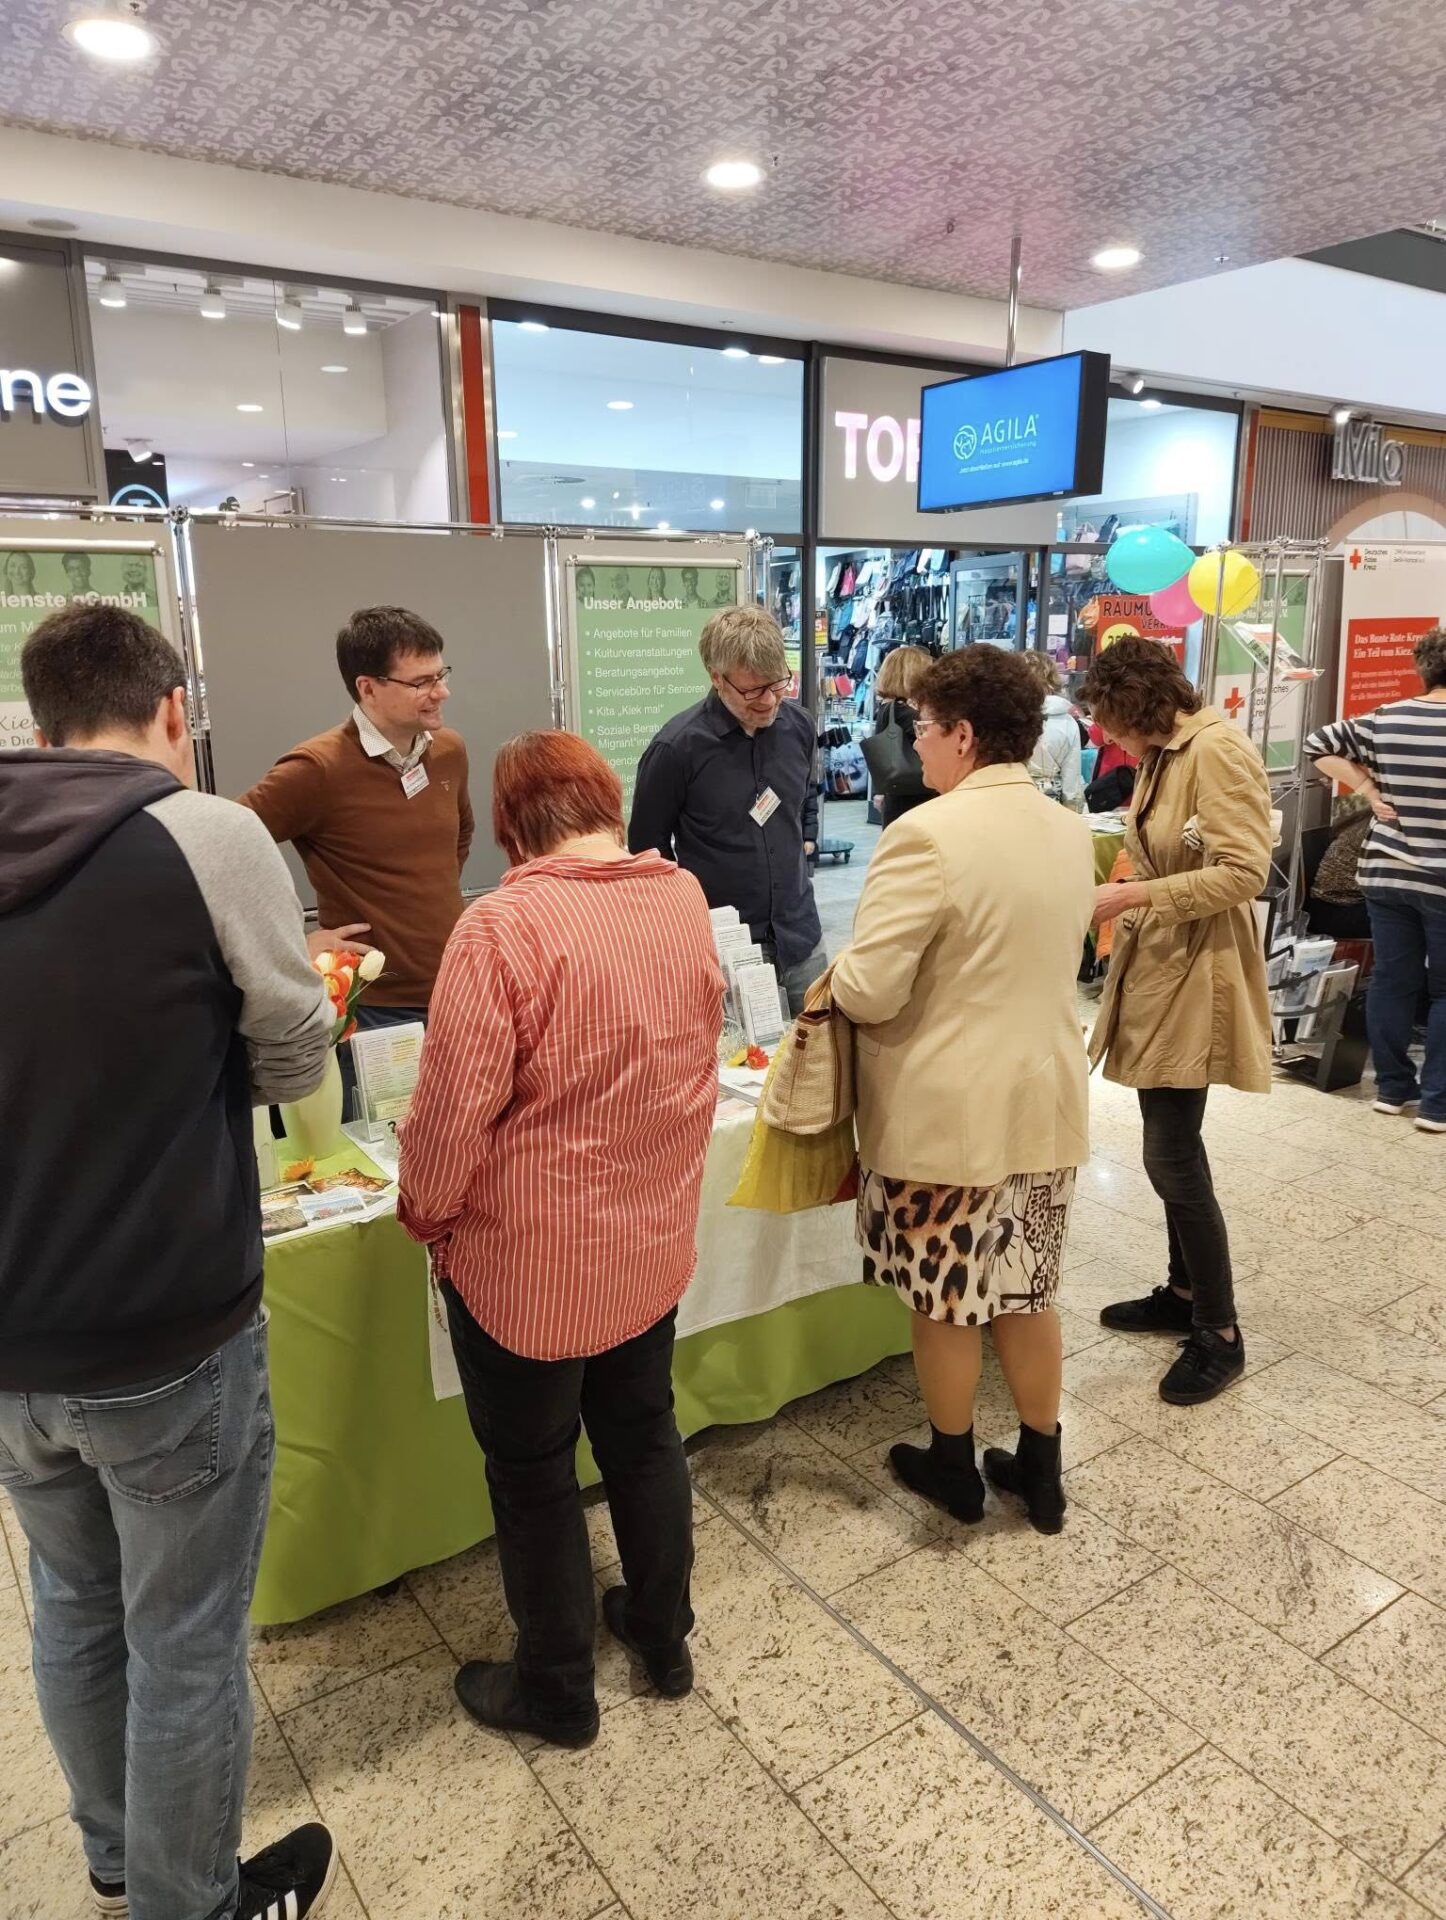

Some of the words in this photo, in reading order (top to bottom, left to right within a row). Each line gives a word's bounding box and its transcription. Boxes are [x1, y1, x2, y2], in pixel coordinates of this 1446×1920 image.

[0, 369, 92, 417] ne
[980, 414, 1037, 446] AGILA
[0, 591, 67, 609] ienste
[583, 596, 624, 611] Unser
[626, 596, 683, 613] Angebot:
[593, 628, 639, 641] Angebote
[641, 627, 654, 639] für
[655, 627, 693, 638] Familien
[1354, 633, 1369, 645] Das
[594, 647, 693, 659] Kulturveranstaltungen
[1367, 647, 1380, 658] Teil
[595, 666, 685, 680] Beratungsangebote
[595, 685, 652, 697] Servicebüro
[653, 684, 665, 695] für
[667, 683, 706, 695] Senioren
[596, 706, 616, 717] Kita
[597, 724, 631, 736] Soziale
[633, 723, 664, 735] Beratu
[11, 735, 34, 747] Die
